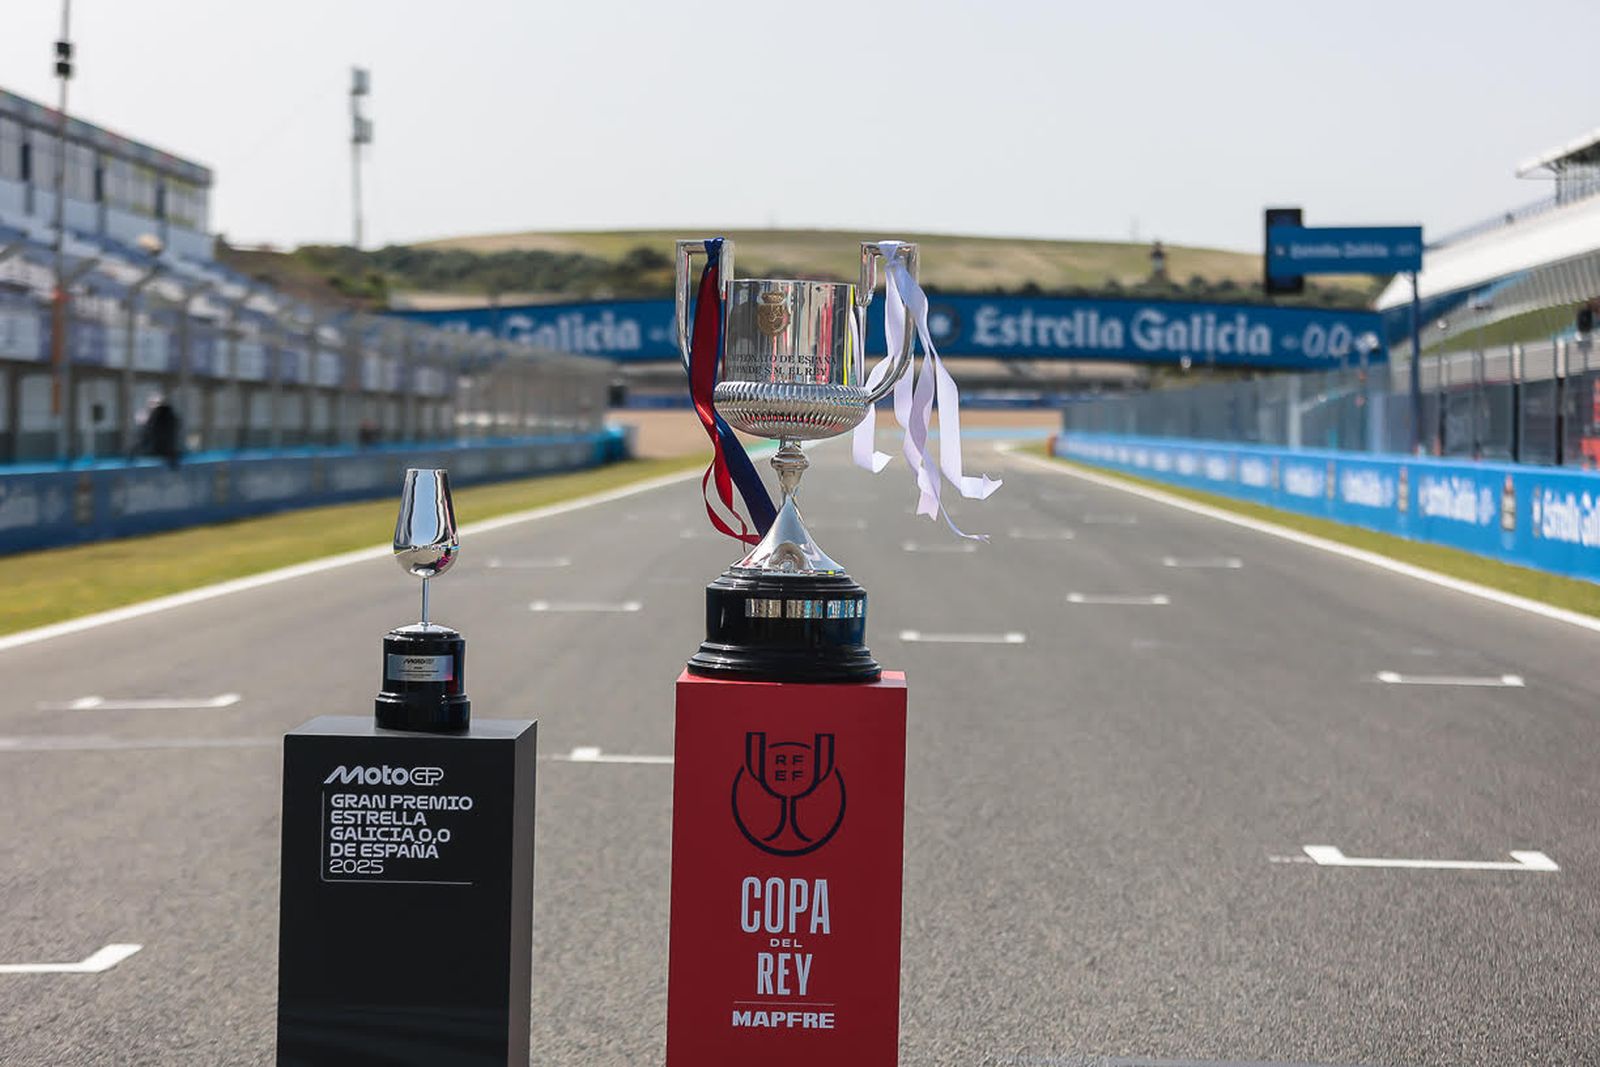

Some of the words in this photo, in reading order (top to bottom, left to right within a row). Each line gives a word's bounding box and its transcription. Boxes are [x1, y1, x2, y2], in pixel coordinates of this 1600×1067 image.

[972, 305, 1124, 349] Estrella
[1130, 307, 1272, 356] Galicia
[780, 355, 795, 363] DE
[788, 367, 803, 375] EL
[805, 367, 826, 376] REY
[324, 765, 444, 786] MotoGP
[331, 794, 386, 808] GRAN
[390, 795, 473, 810] PREMIO
[330, 810, 427, 826] ESTRELLA
[330, 826, 415, 842] GALICIA
[330, 843, 356, 857] DE
[360, 841, 439, 859] ESPAÑA
[329, 859, 384, 874] 2025
[740, 876, 830, 935] COPA
[770, 938, 803, 948] DEL
[757, 952, 813, 996] REY
[732, 1010, 835, 1029] MAPFRE
